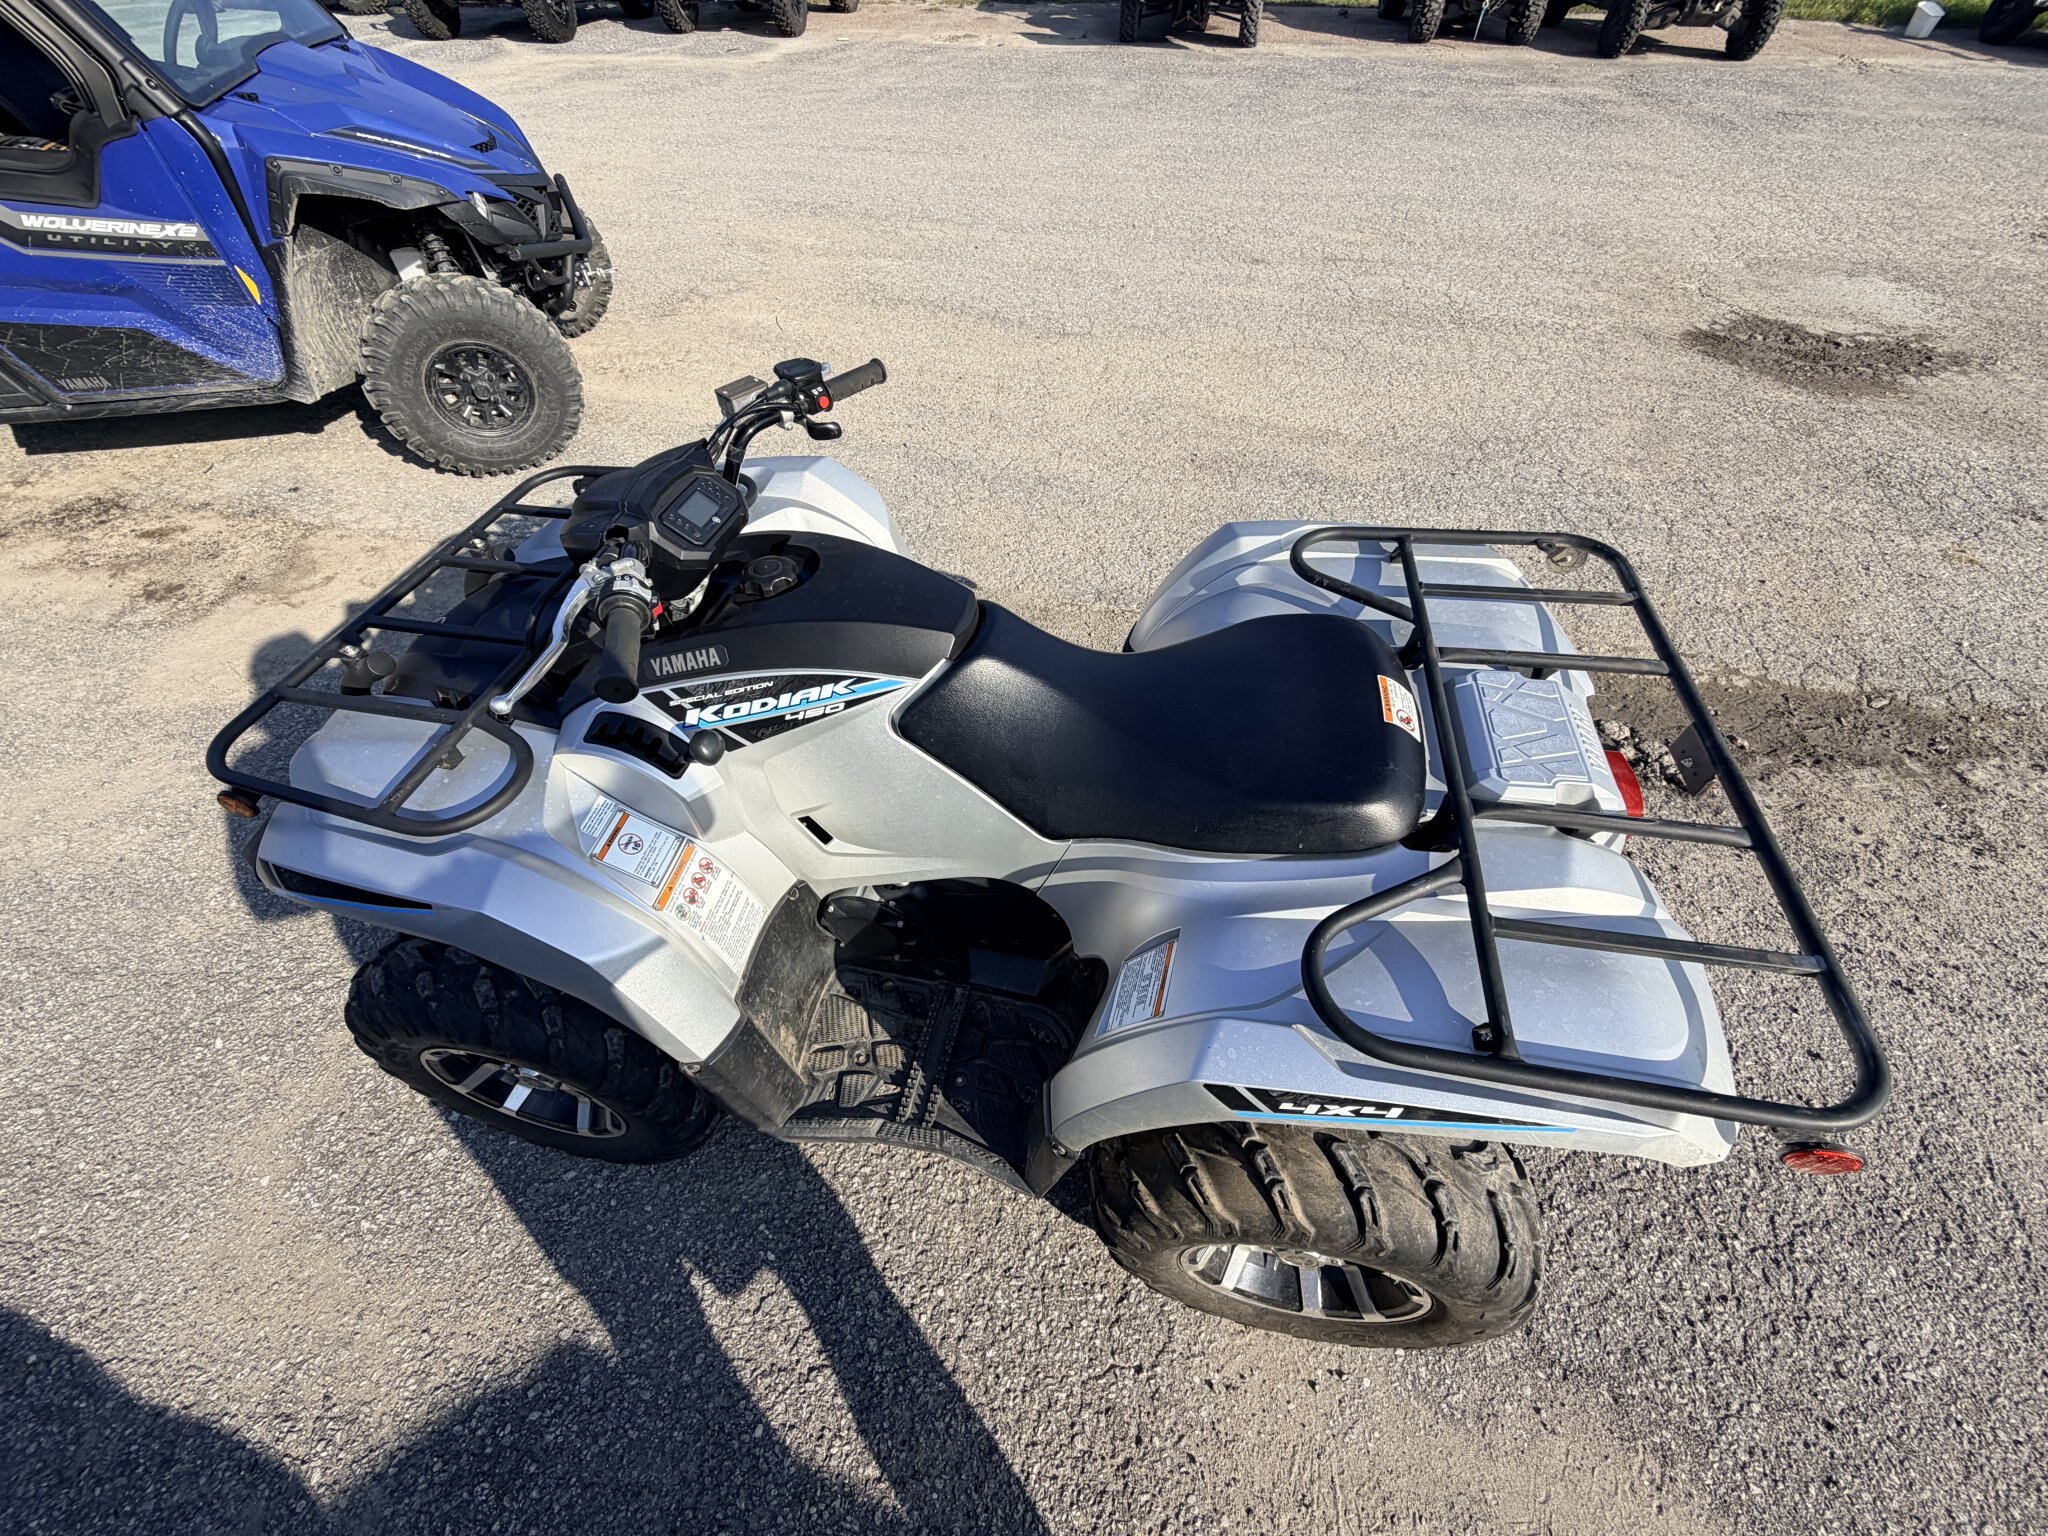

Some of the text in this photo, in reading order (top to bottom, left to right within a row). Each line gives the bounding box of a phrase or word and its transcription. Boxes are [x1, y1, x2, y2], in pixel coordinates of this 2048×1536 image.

[47, 234, 173, 248] UTILITY
[57, 375, 112, 390] YAMAHA
[650, 647, 721, 677] YAMAHA
[669, 680, 774, 707] SPECIAL EDITION
[683, 678, 858, 727] KODIAK
[785, 702, 846, 721] 450
[632, 841, 641, 851] 16
[670, 857, 687, 886] WARNING
[1278, 1102, 1404, 1118] 4X4
